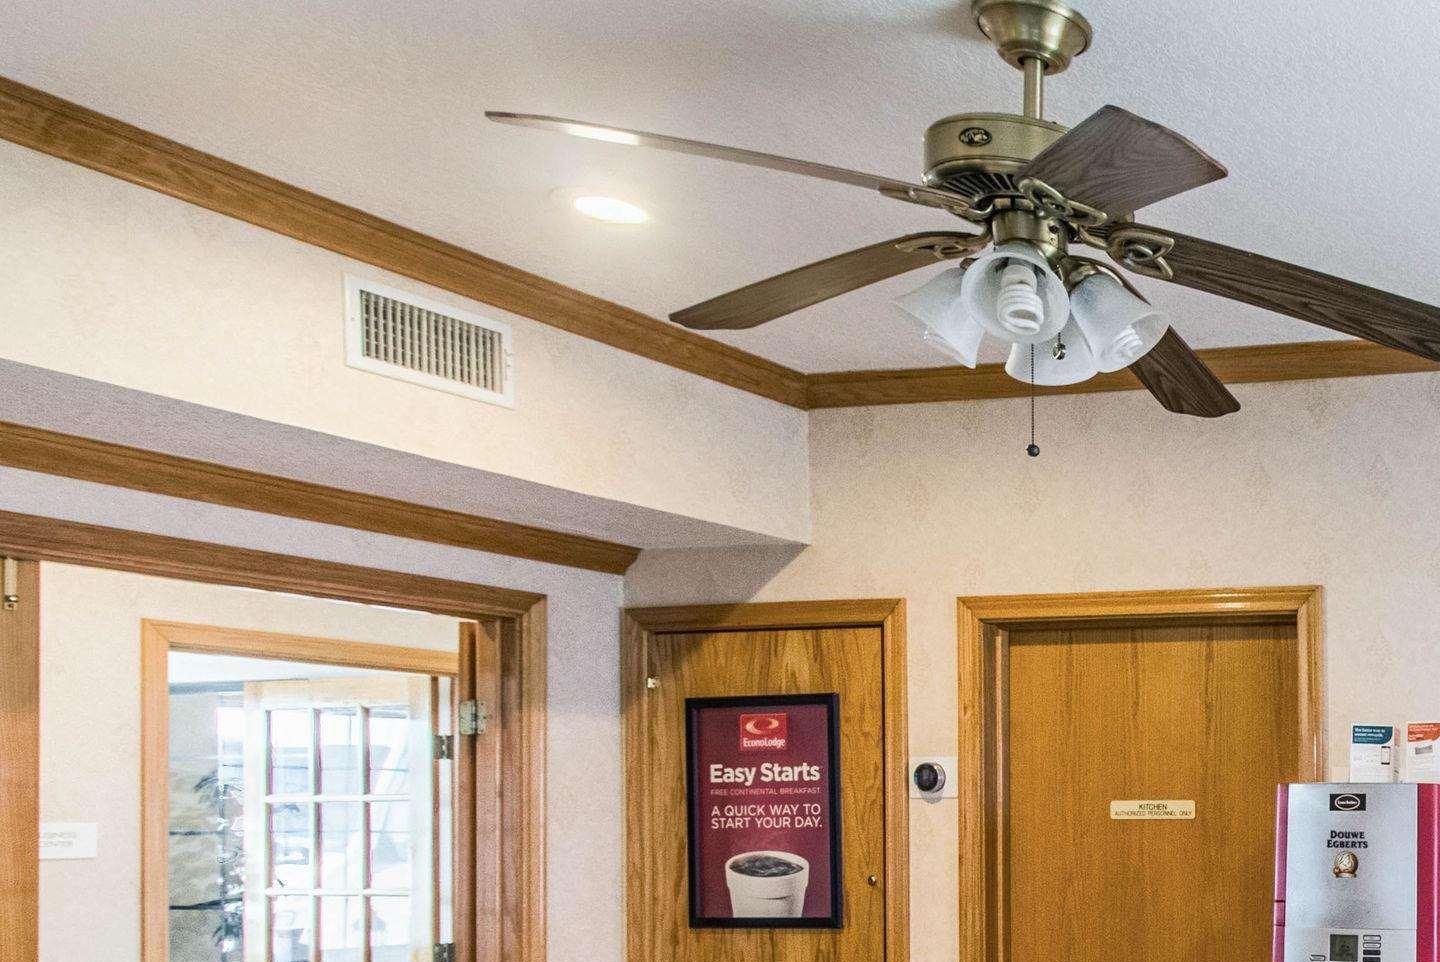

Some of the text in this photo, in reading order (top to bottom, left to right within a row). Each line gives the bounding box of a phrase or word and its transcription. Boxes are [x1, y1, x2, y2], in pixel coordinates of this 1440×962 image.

[710, 762, 820, 786] Easy Starts
[711, 786, 820, 796] FREE CONTINENTAL BREAKFAST
[711, 803, 821, 817] A QUICK WAY TO
[711, 816, 823, 829] START YOUR DAY.
[1330, 830, 1365, 839] DOUWE
[1327, 840, 1368, 849] EGBERTS
